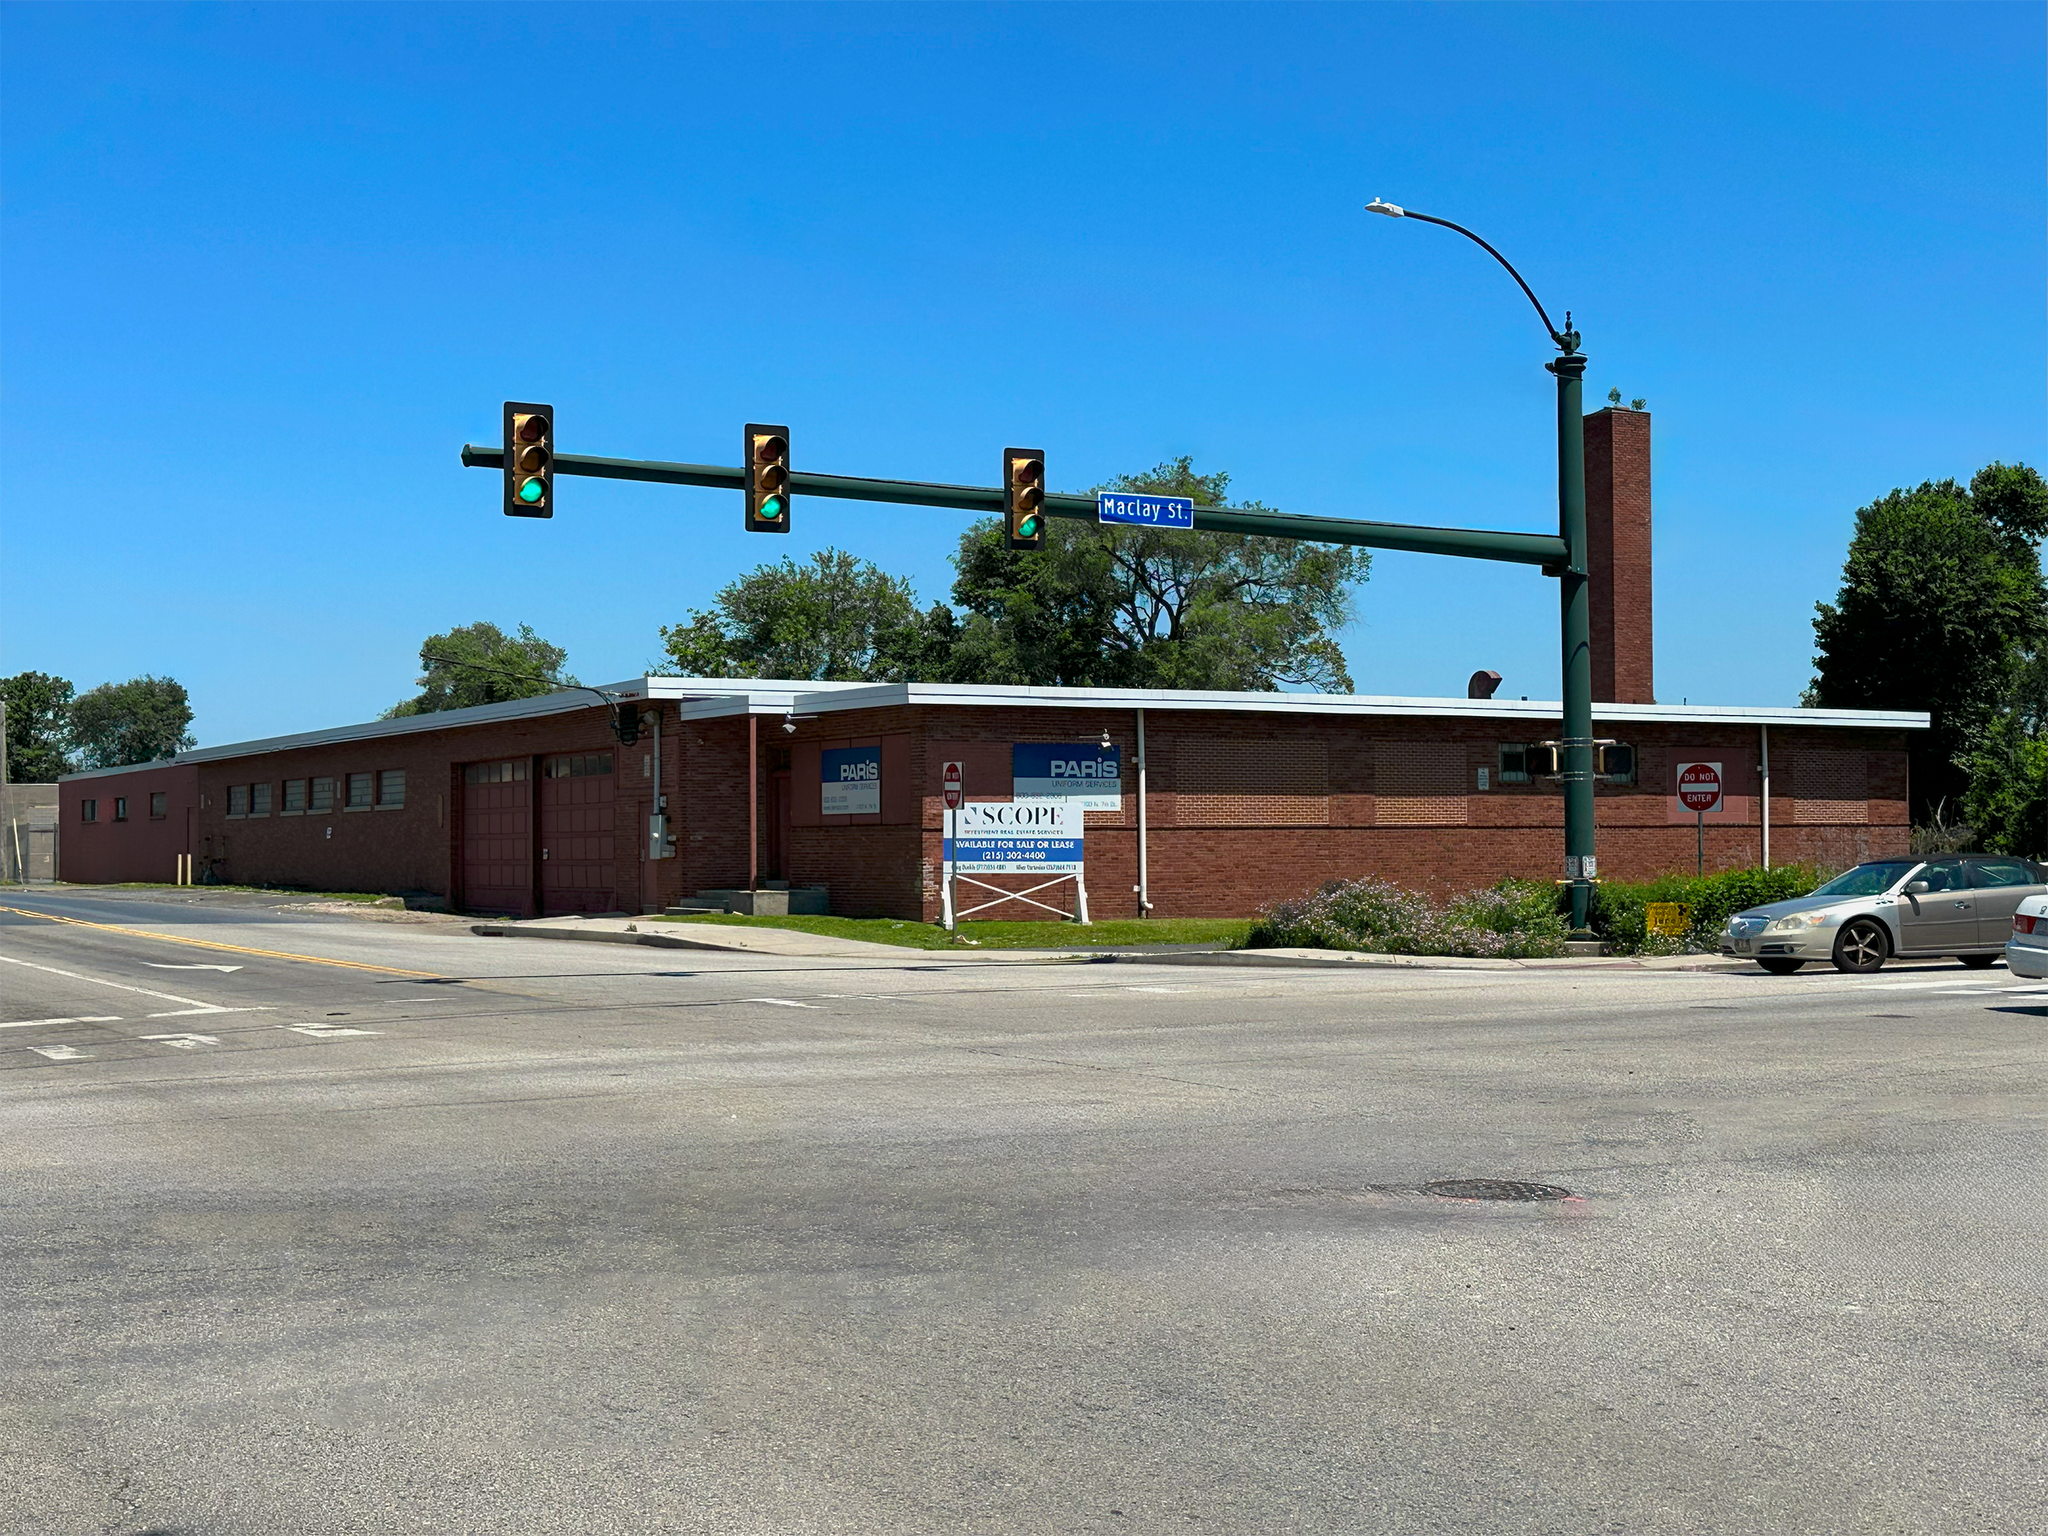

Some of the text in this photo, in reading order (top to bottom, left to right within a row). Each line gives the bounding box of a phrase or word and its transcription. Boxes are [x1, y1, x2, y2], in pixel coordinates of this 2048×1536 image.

[1104, 498, 1188, 521] Maclay St.
[1684, 773, 1715, 781] DO NOT
[1687, 794, 1712, 803] ENTER
[997, 840, 1014, 849] FOR
[1016, 840, 1035, 849] SALE
[1036, 840, 1049, 849] OR
[1051, 840, 1075, 849] LEASE
[982, 851, 1046, 861] (215) 302-4400
